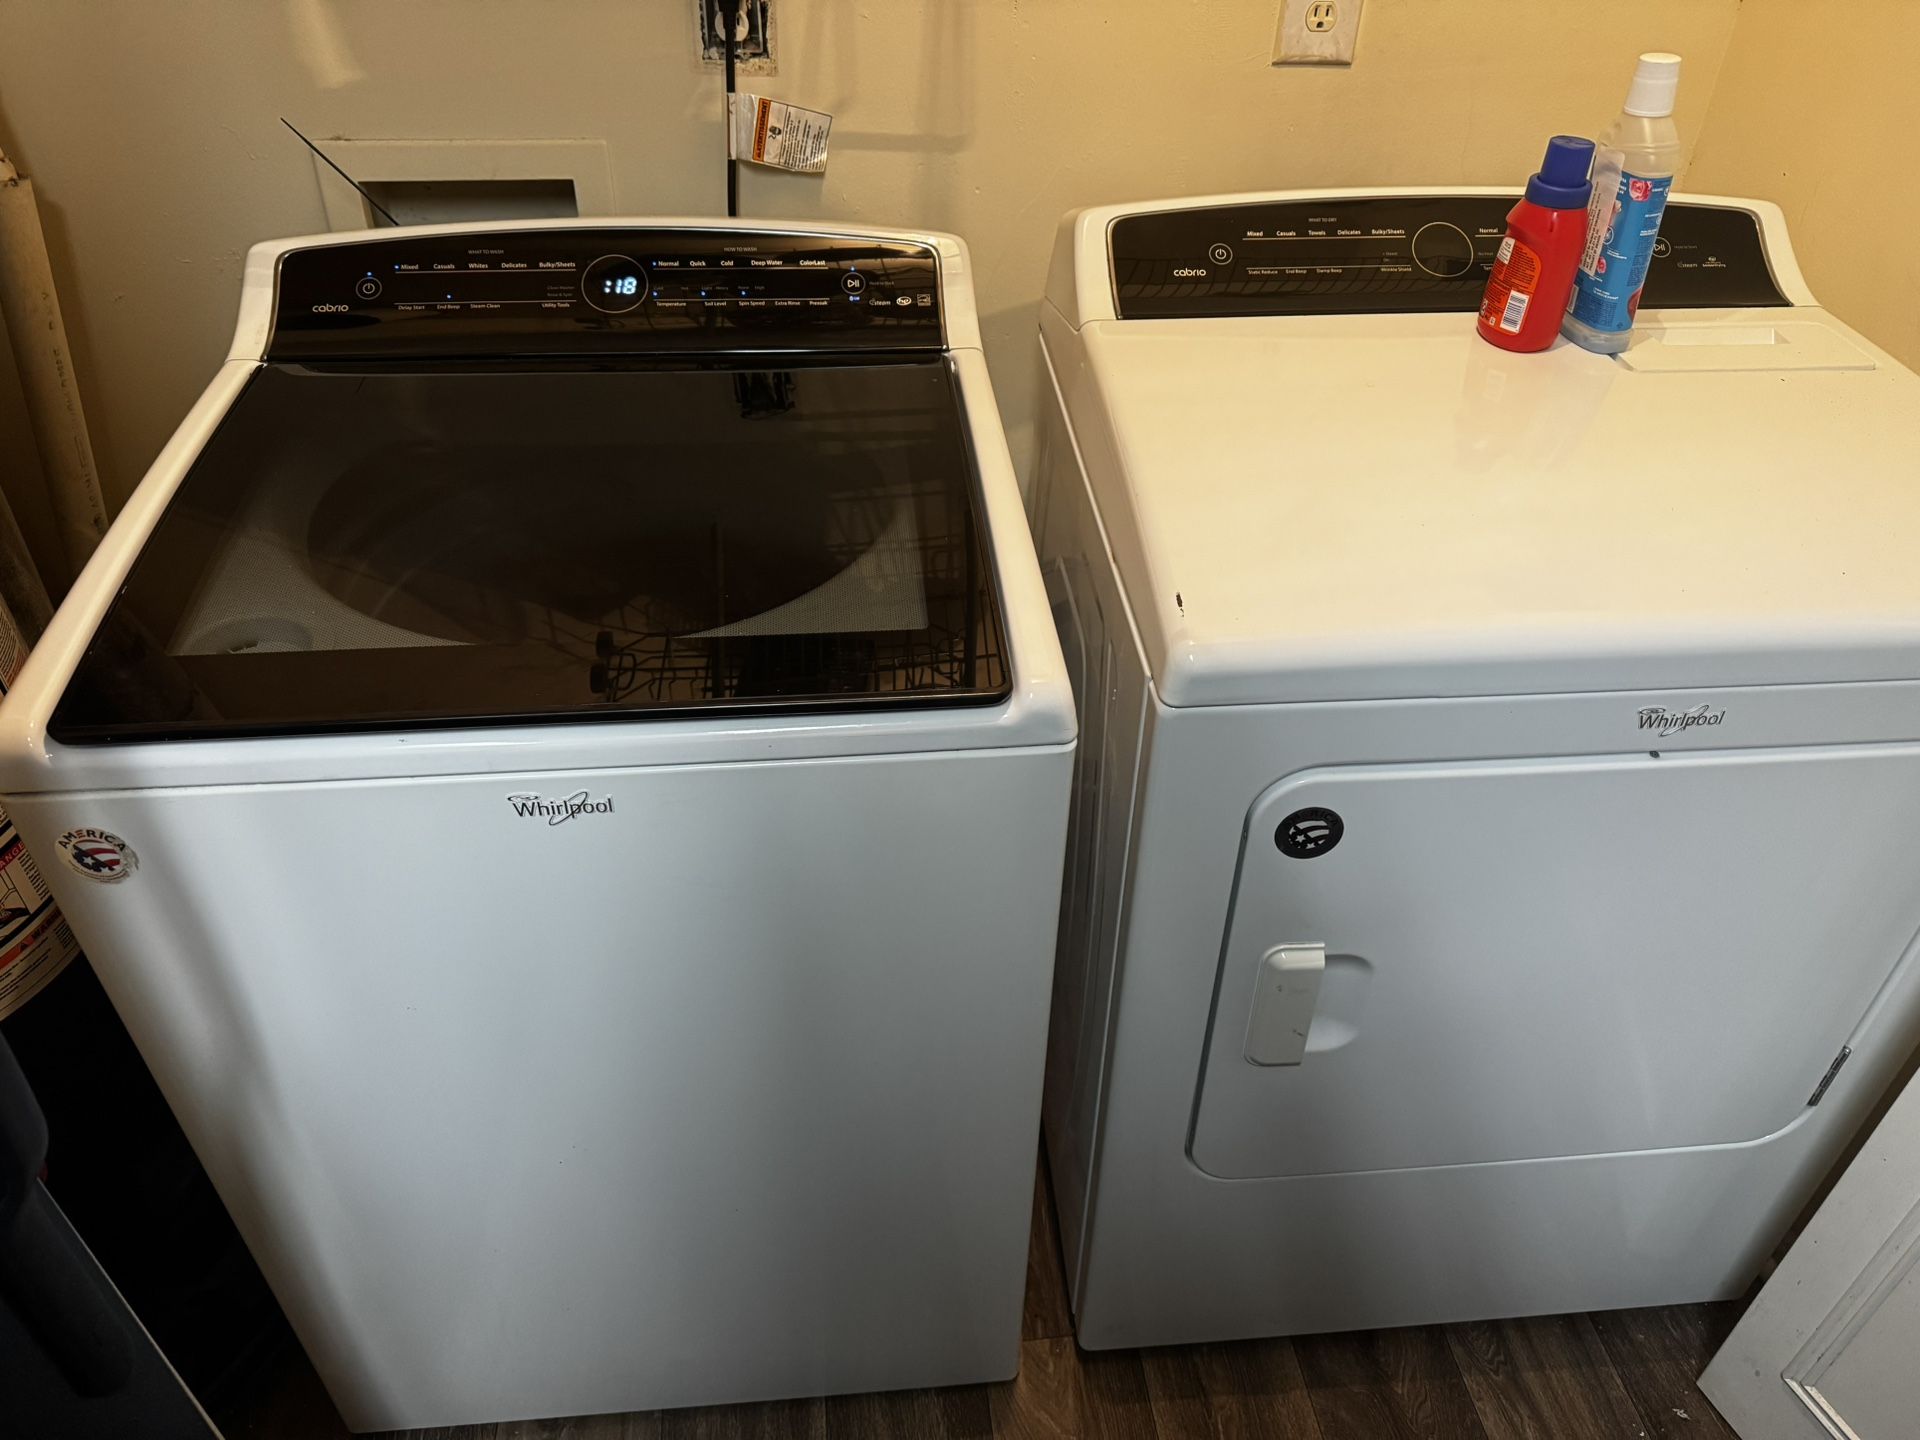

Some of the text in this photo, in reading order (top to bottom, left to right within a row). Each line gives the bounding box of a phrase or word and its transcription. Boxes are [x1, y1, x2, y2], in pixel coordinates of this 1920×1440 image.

[1173, 267, 1207, 277] cabrio
[604, 276, 638, 295] :18
[312, 303, 349, 313] cabrio
[1638, 705, 1726, 734] Whirlpool
[509, 793, 613, 822] Whirlpool
[58, 829, 126, 851] AMERICA
